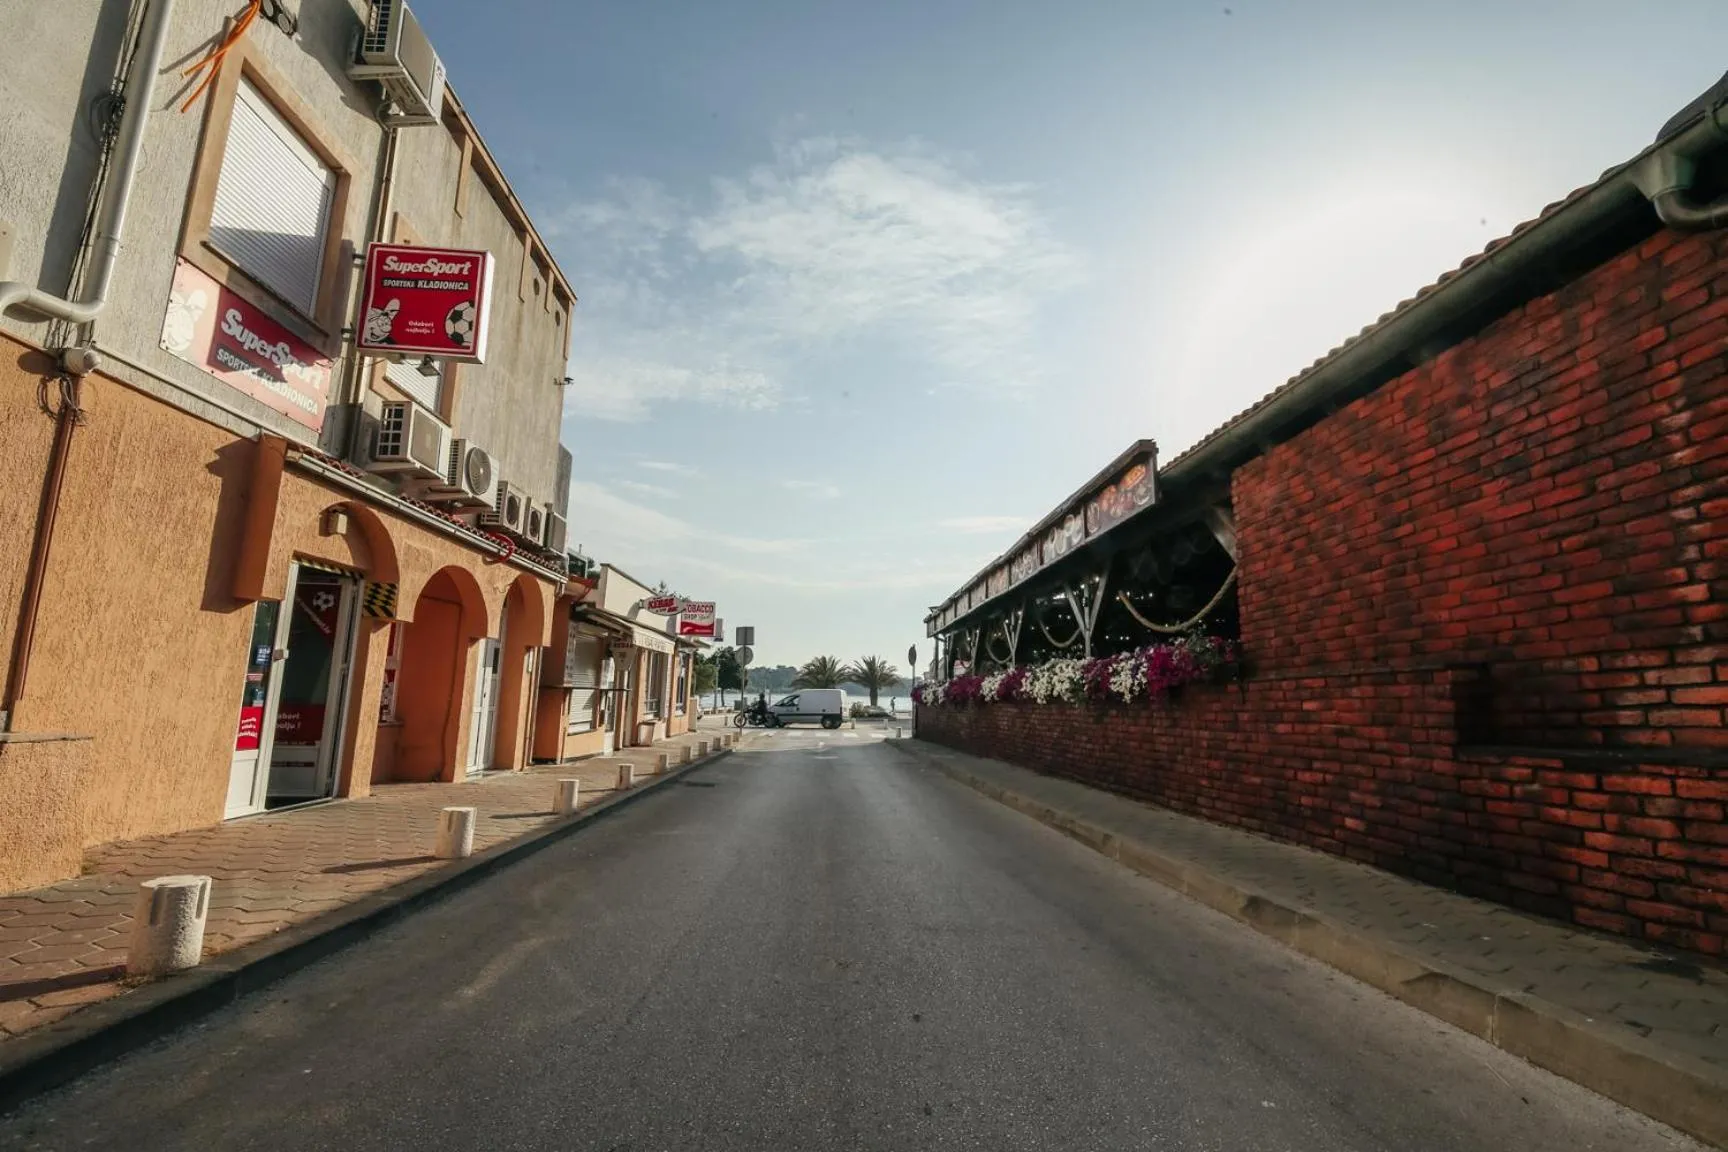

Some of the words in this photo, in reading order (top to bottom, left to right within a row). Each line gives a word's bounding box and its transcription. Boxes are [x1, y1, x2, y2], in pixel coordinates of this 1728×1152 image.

[382, 255, 472, 276] SuperSport
[383, 278, 415, 288] SPORTSKA
[417, 279, 469, 290] KLADIONICA
[221, 308, 323, 389] SuperSport
[261, 375, 318, 415] KLADIONICA
